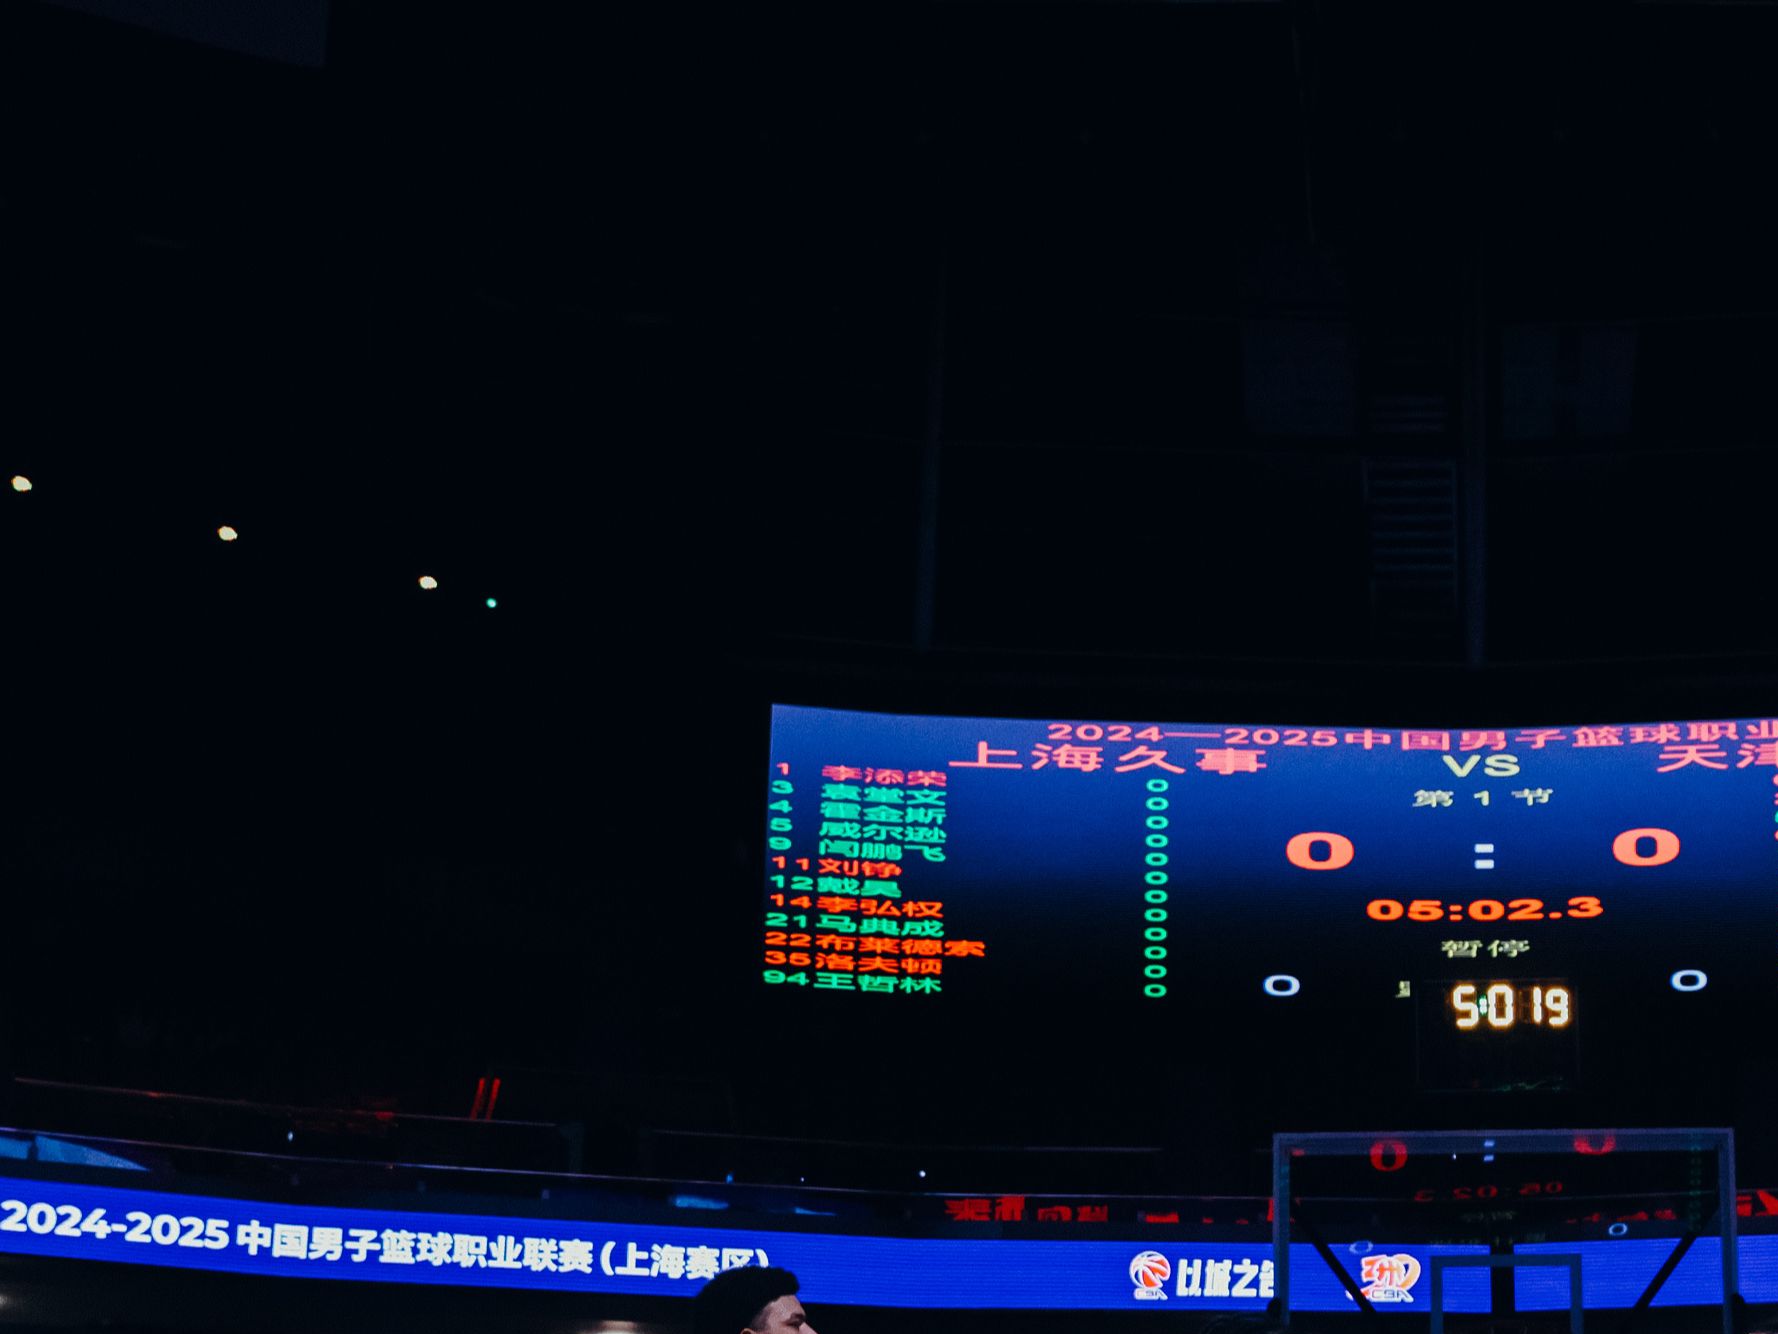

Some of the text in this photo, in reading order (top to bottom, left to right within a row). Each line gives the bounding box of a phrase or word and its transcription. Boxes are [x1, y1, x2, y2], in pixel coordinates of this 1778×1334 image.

[948, 741, 1268, 776] 上海久事
[1442, 754, 1520, 777] VS
[777, 763, 789, 775] 1
[772, 780, 794, 794] 3
[1147, 779, 1169, 793] 0
[770, 800, 792, 813] 4
[1146, 797, 1168, 811] 0
[770, 818, 792, 832] 5
[1146, 816, 1168, 829] 0
[769, 837, 791, 850] 9
[1146, 835, 1168, 848] 0
[1286, 831, 1355, 871] 0
[1612, 827, 1681, 867] 0
[772, 856, 809, 871] 11
[1146, 853, 1168, 866] 0
[770, 876, 812, 890] 12
[1145, 872, 1167, 885] 0
[1145, 890, 1167, 904] 0
[771, 894, 943, 918] 14 李弘权
[1366, 896, 1604, 921] 05:02.3
[1145, 909, 1167, 922] 0
[765, 913, 944, 937] 21 马典成
[1145, 927, 1167, 941] 0
[765, 932, 985, 957] 22 布莱德索
[1145, 946, 1166, 959] 0
[765, 951, 942, 975] 35 洛夫顿
[1145, 965, 1166, 979] 0
[763, 970, 942, 993] 94 王哲林
[1263, 974, 1301, 997] 0
[1670, 969, 1708, 992] 0
[1144, 983, 1166, 997] 0
[0, 1199, 230, 1250] 2024-2025
